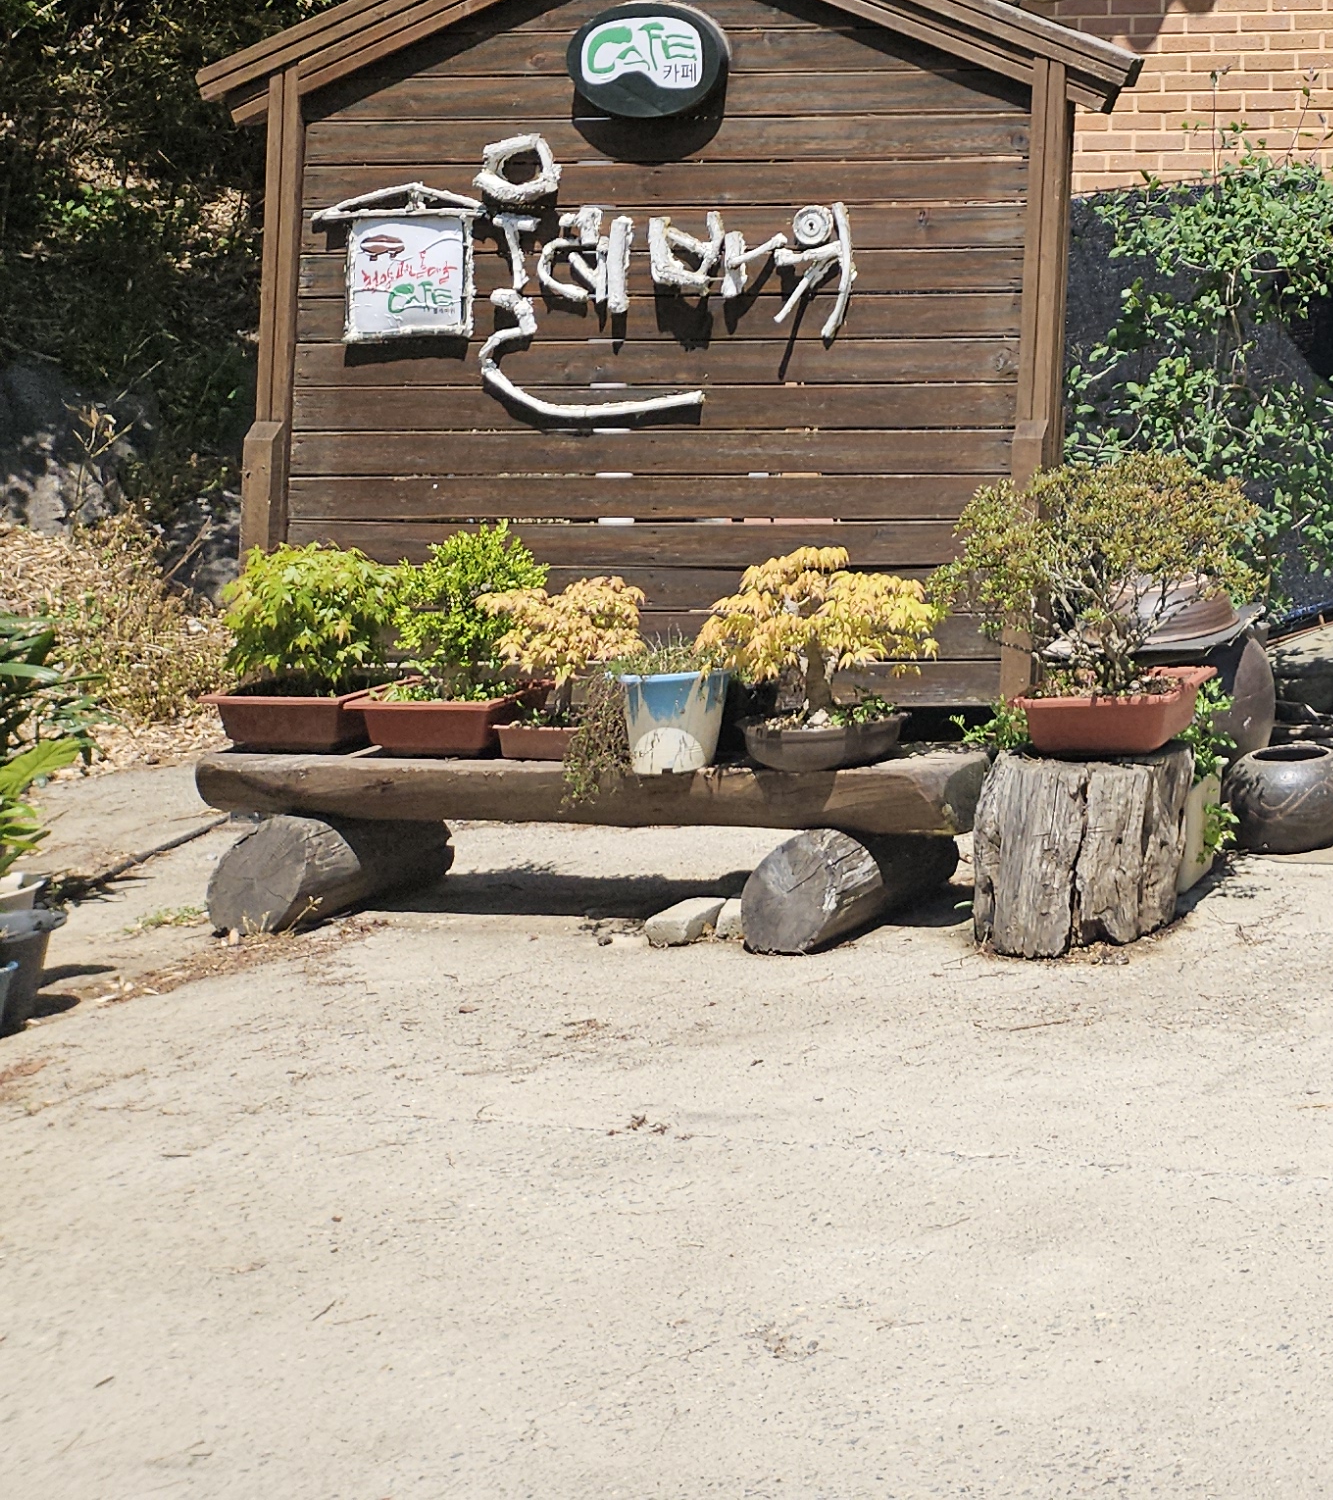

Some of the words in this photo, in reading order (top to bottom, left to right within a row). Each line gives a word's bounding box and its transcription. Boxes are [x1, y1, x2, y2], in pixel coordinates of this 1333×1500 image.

[587, 21, 698, 75] CAFE
[662, 62, 697, 83] 카페
[387, 281, 453, 314] CAFE
